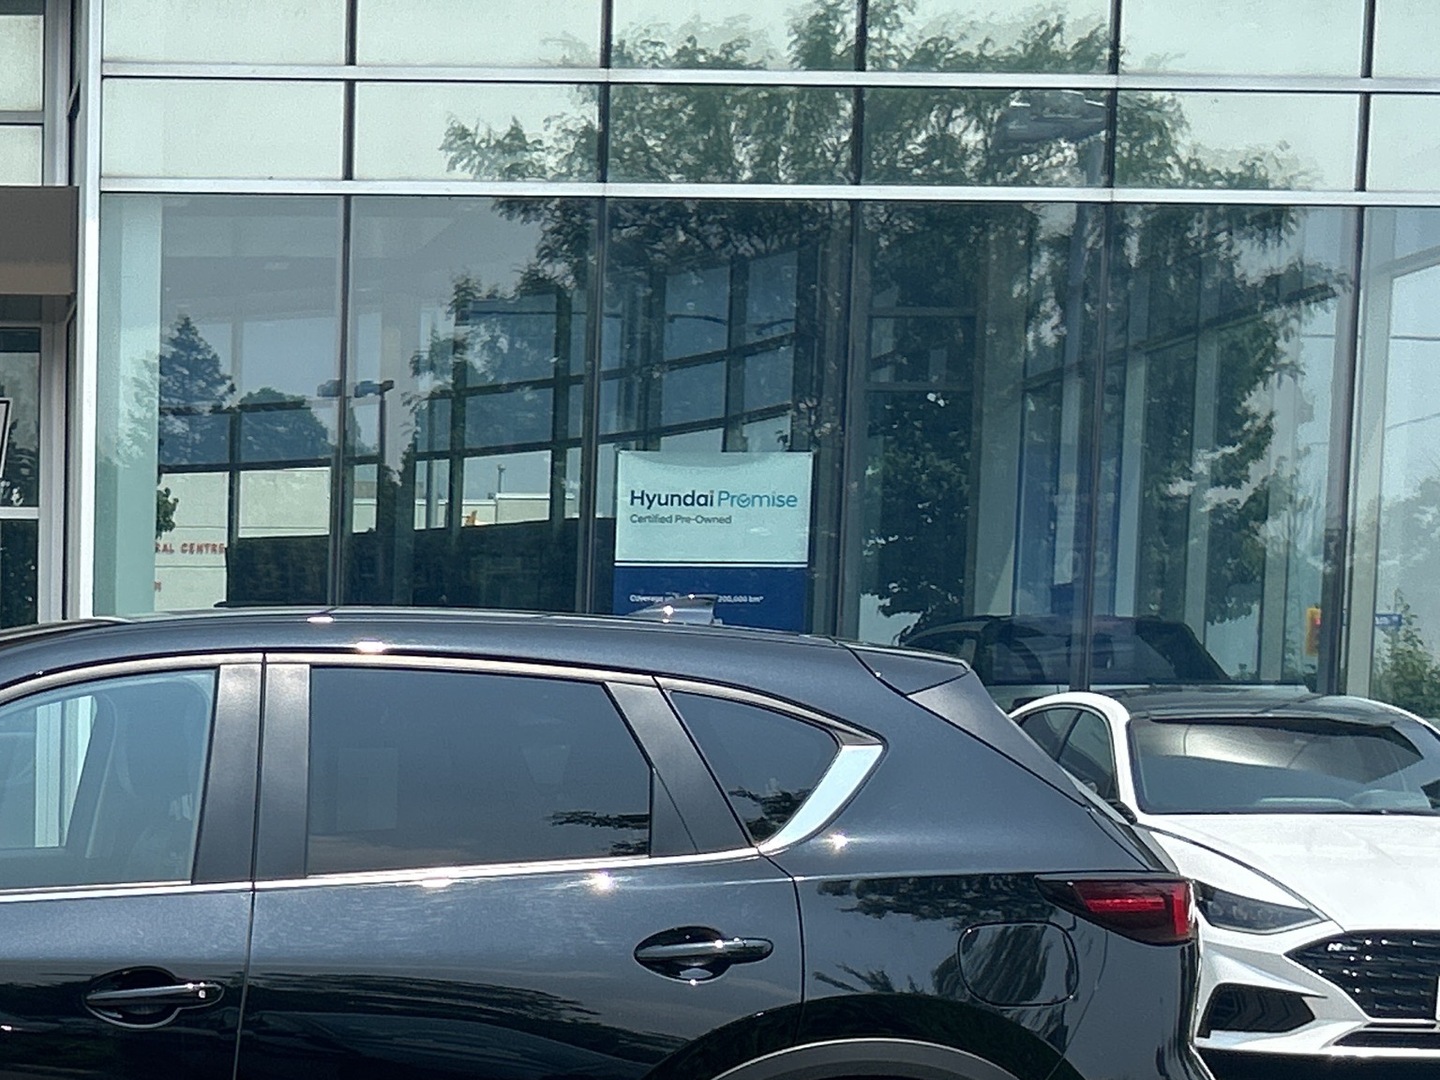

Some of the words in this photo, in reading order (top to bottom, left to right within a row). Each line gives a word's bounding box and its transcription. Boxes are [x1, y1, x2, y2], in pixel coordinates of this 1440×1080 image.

[629, 490, 714, 509] Hyundai
[717, 490, 798, 508] Promise
[629, 514, 673, 524] Certified
[675, 514, 732, 524] Pre-Owned
